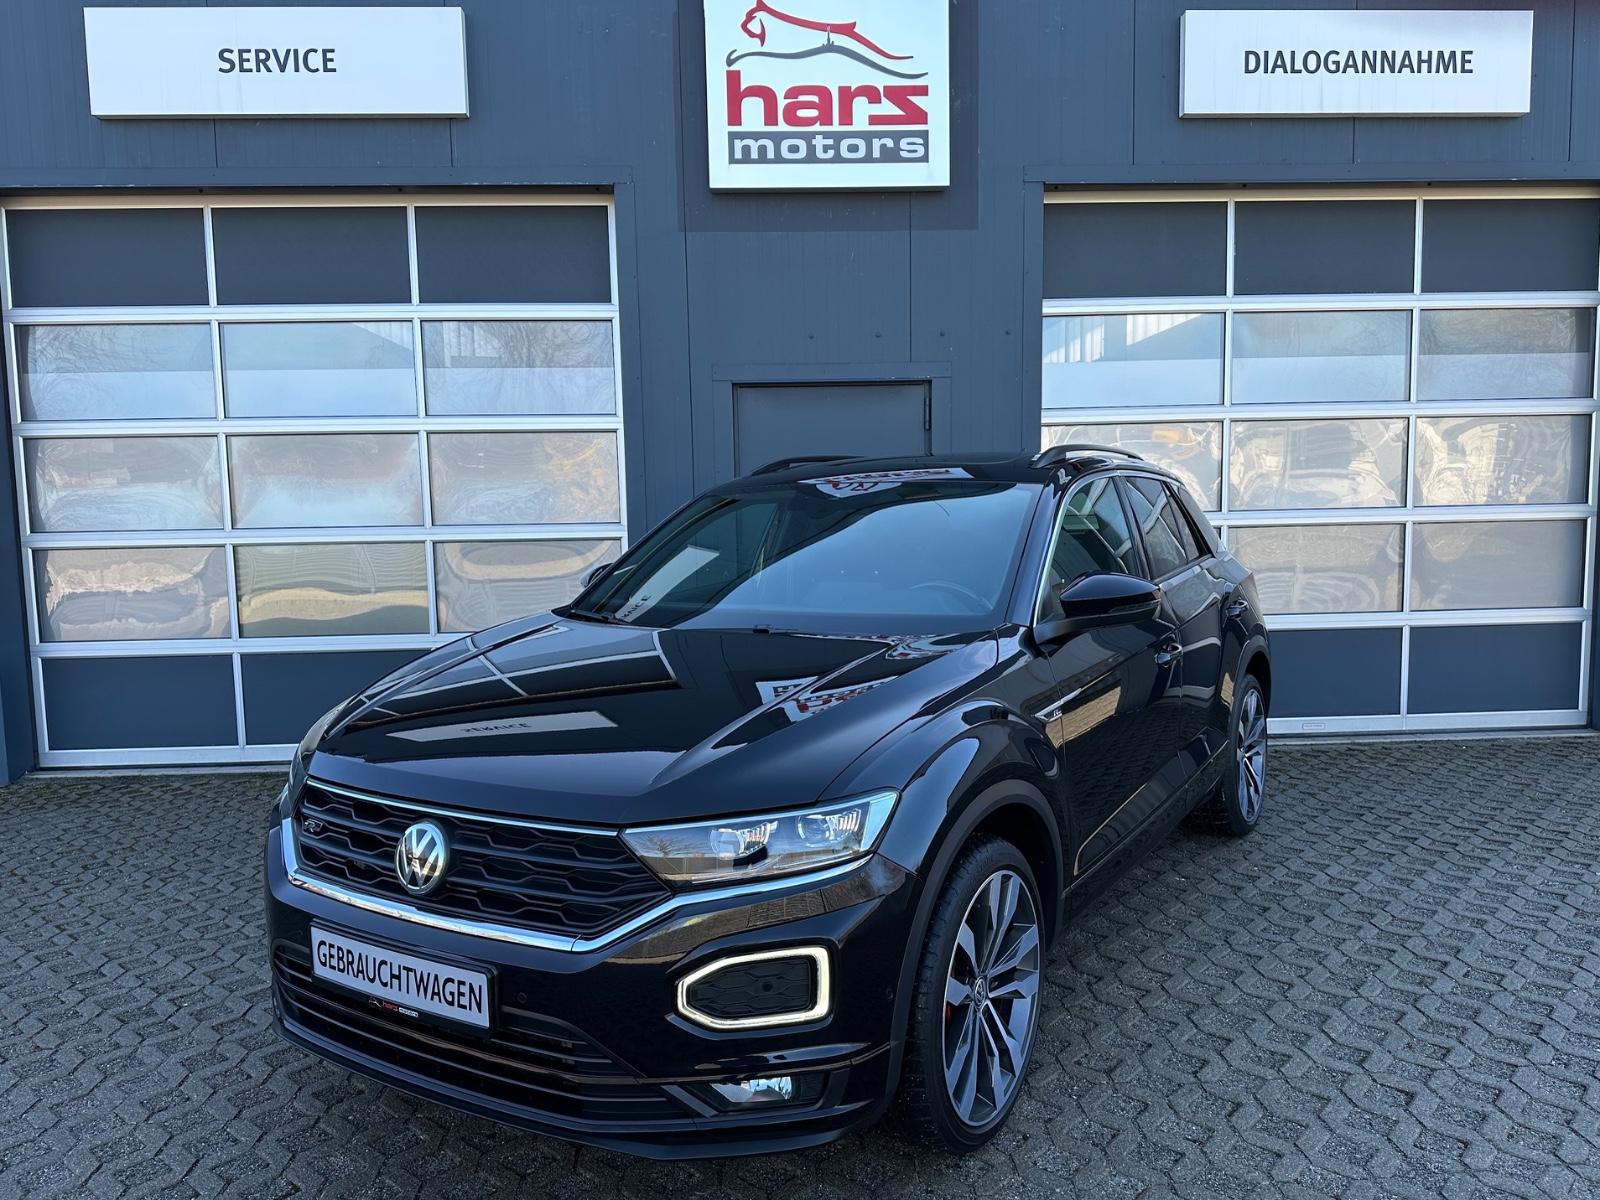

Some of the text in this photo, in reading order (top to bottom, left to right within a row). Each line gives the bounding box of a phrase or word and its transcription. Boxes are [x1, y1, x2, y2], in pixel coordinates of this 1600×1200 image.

[218, 48, 337, 74] SERVICE
[1244, 49, 1474, 74] DIALOGANNAHME
[733, 134, 925, 160] motors
[317, 939, 482, 1014] GEBRAUCHTWAGEN
